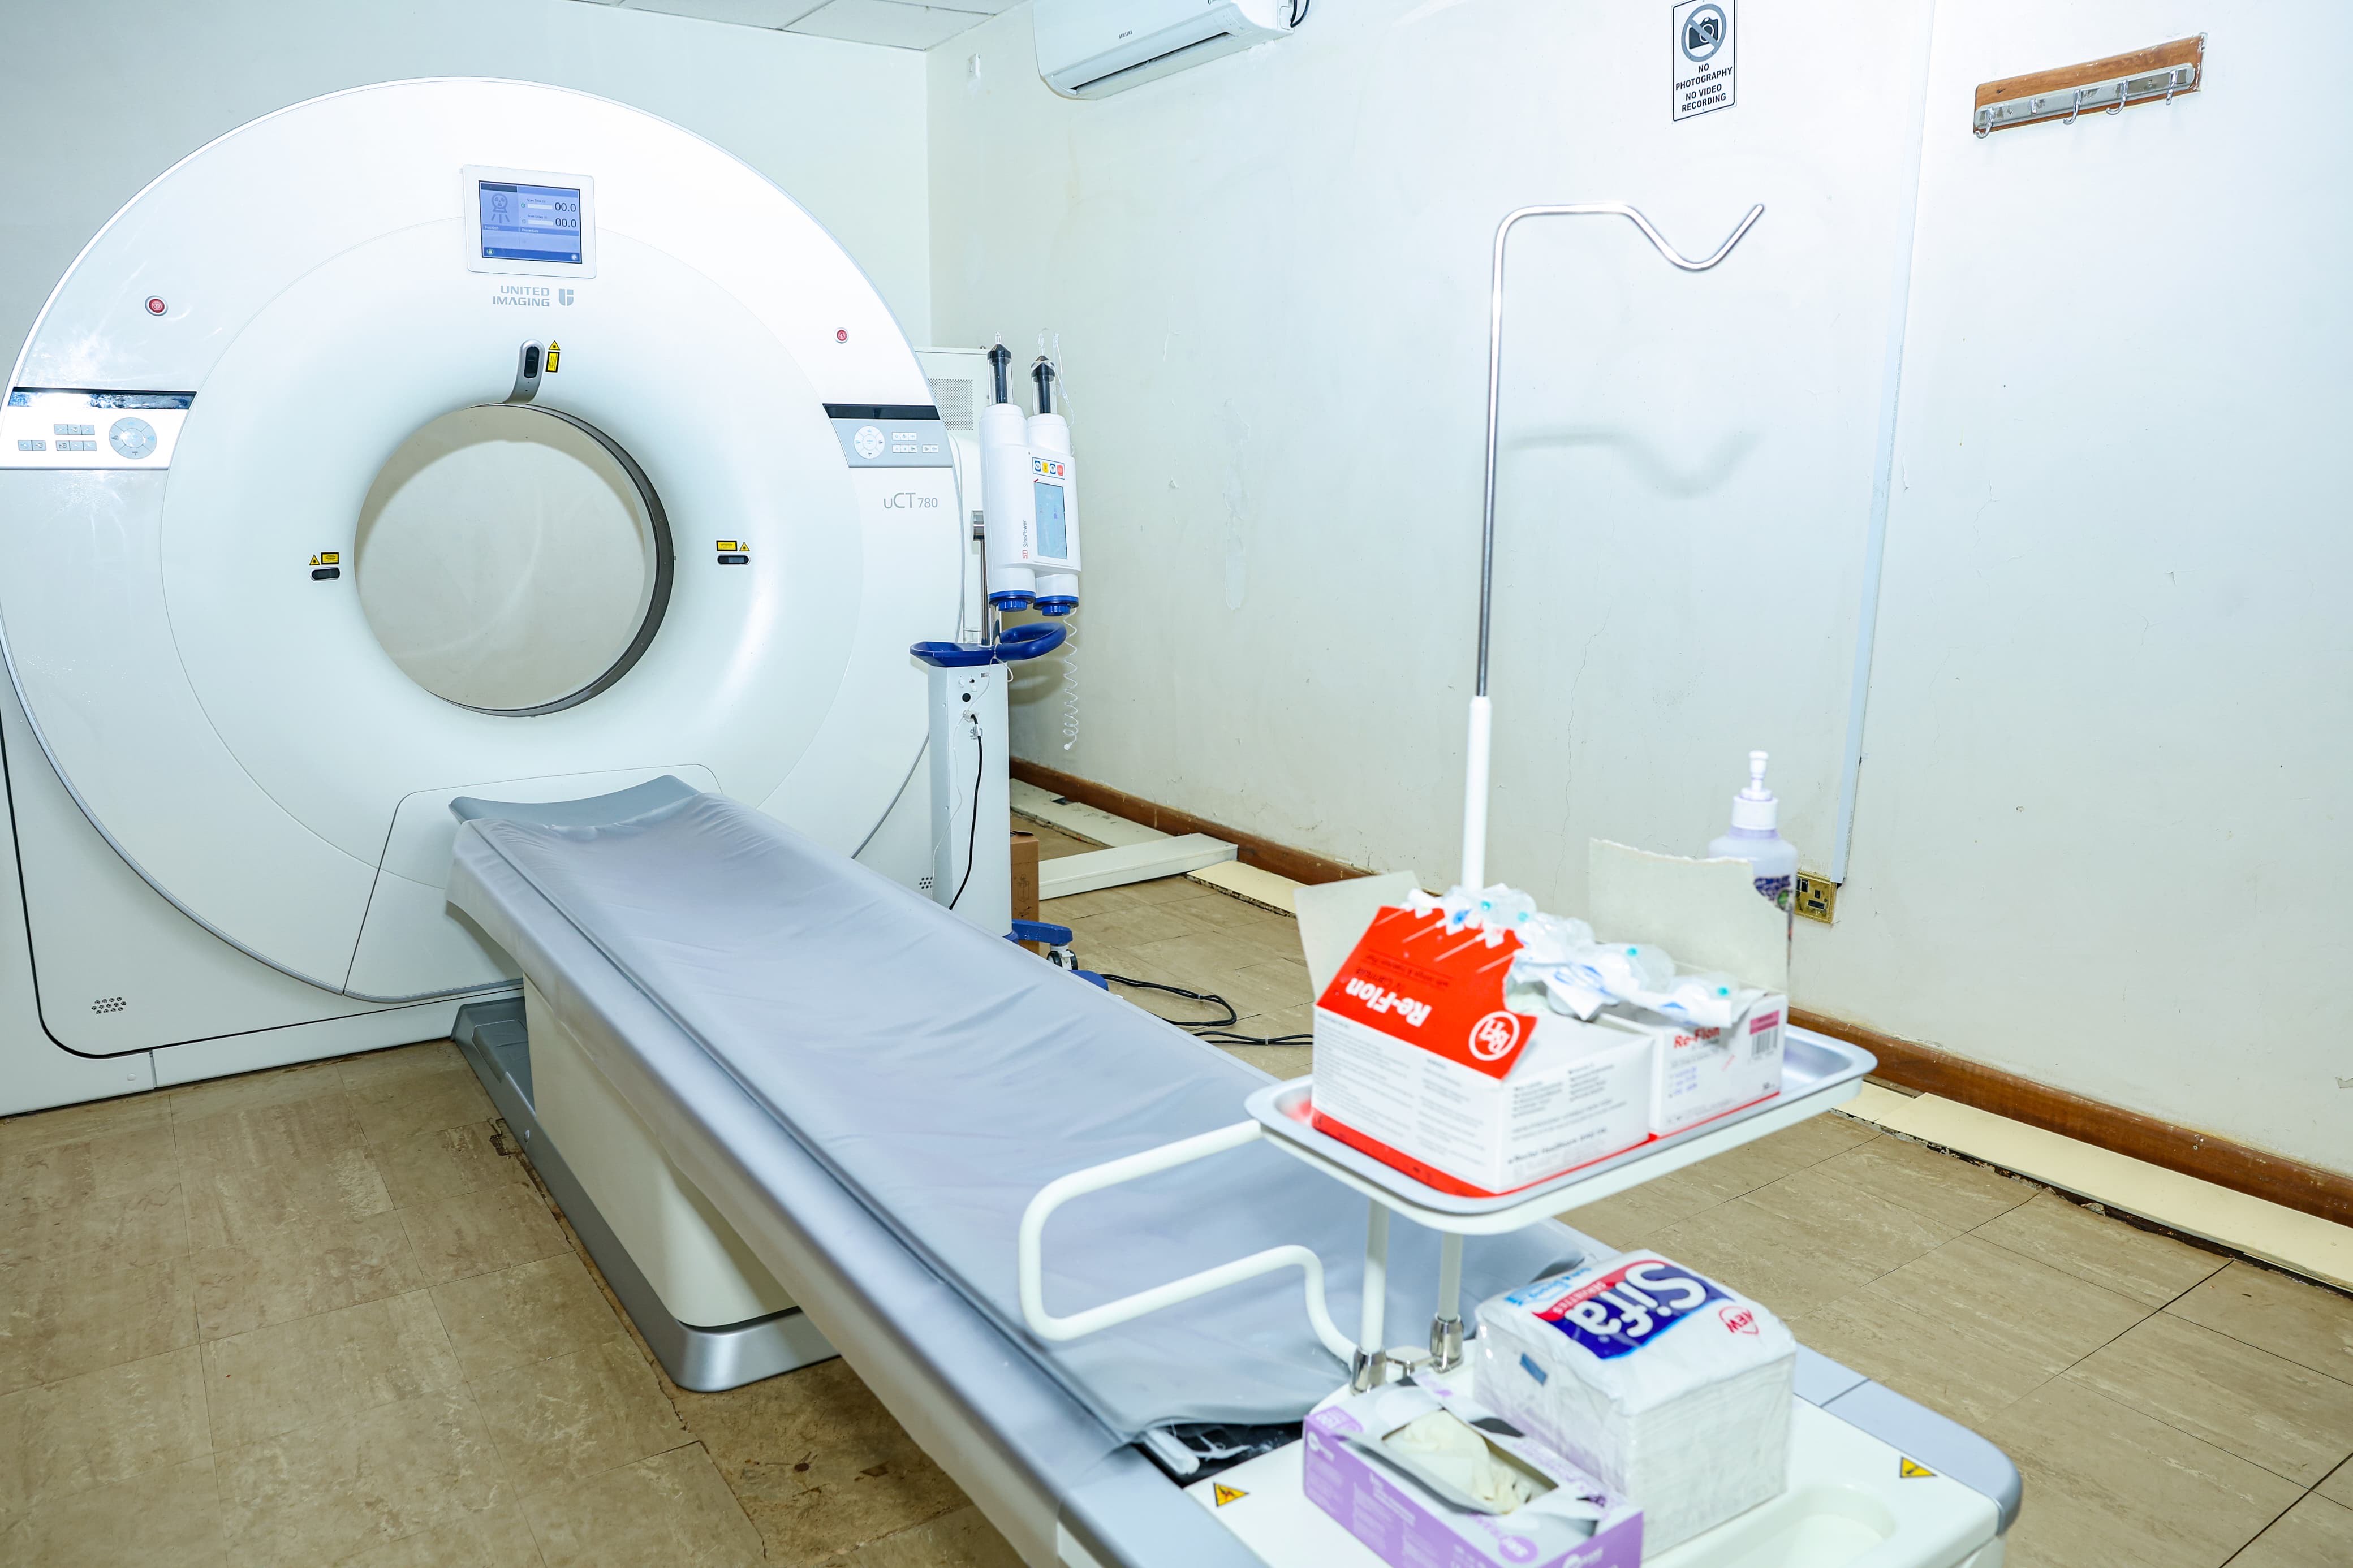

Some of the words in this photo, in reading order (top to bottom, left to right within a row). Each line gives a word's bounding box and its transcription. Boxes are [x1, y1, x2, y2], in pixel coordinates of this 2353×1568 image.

[1698, 63, 1709, 74] NO
[1675, 66, 1733, 90] PHOTOGRAPHY
[1686, 91, 1696, 101] NO
[1699, 84, 1722, 97] VIDEO
[1682, 93, 1726, 112] RECORDING
[554, 202, 576, 212] 00.0
[555, 218, 577, 228] 00.0
[501, 285, 550, 296] UNITED
[493, 296, 550, 307] IMAGING
[884, 492, 916, 509] uCT
[917, 497, 938, 508] 780
[1345, 977, 1432, 1027] Re-Flon
[1565, 1262, 1706, 1338] Sifa
